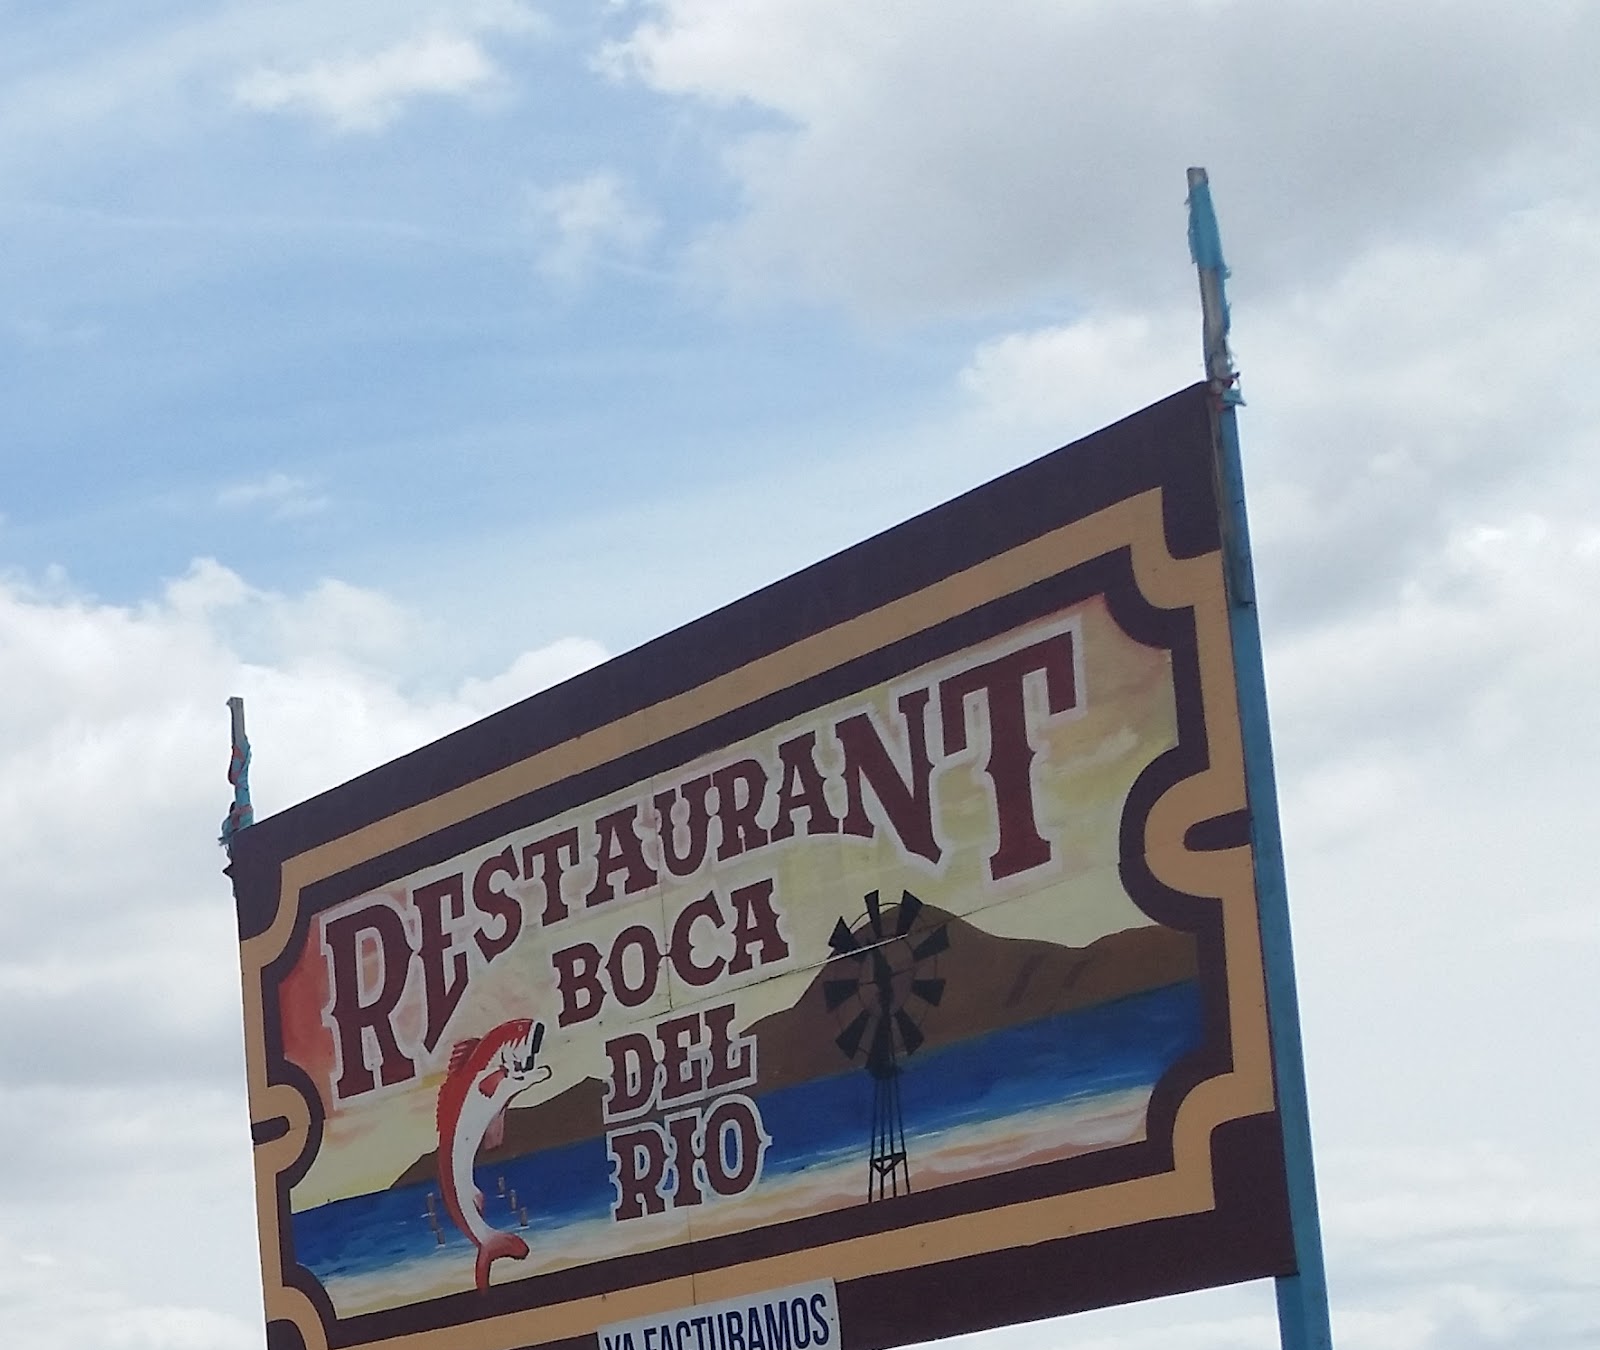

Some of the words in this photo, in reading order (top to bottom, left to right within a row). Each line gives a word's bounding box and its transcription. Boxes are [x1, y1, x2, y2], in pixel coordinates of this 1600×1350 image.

[320, 626, 1079, 1101] RESTAURANT
[552, 878, 789, 1027] BOCA
[603, 1003, 756, 1120] DEL
[609, 1101, 768, 1222] RIO
